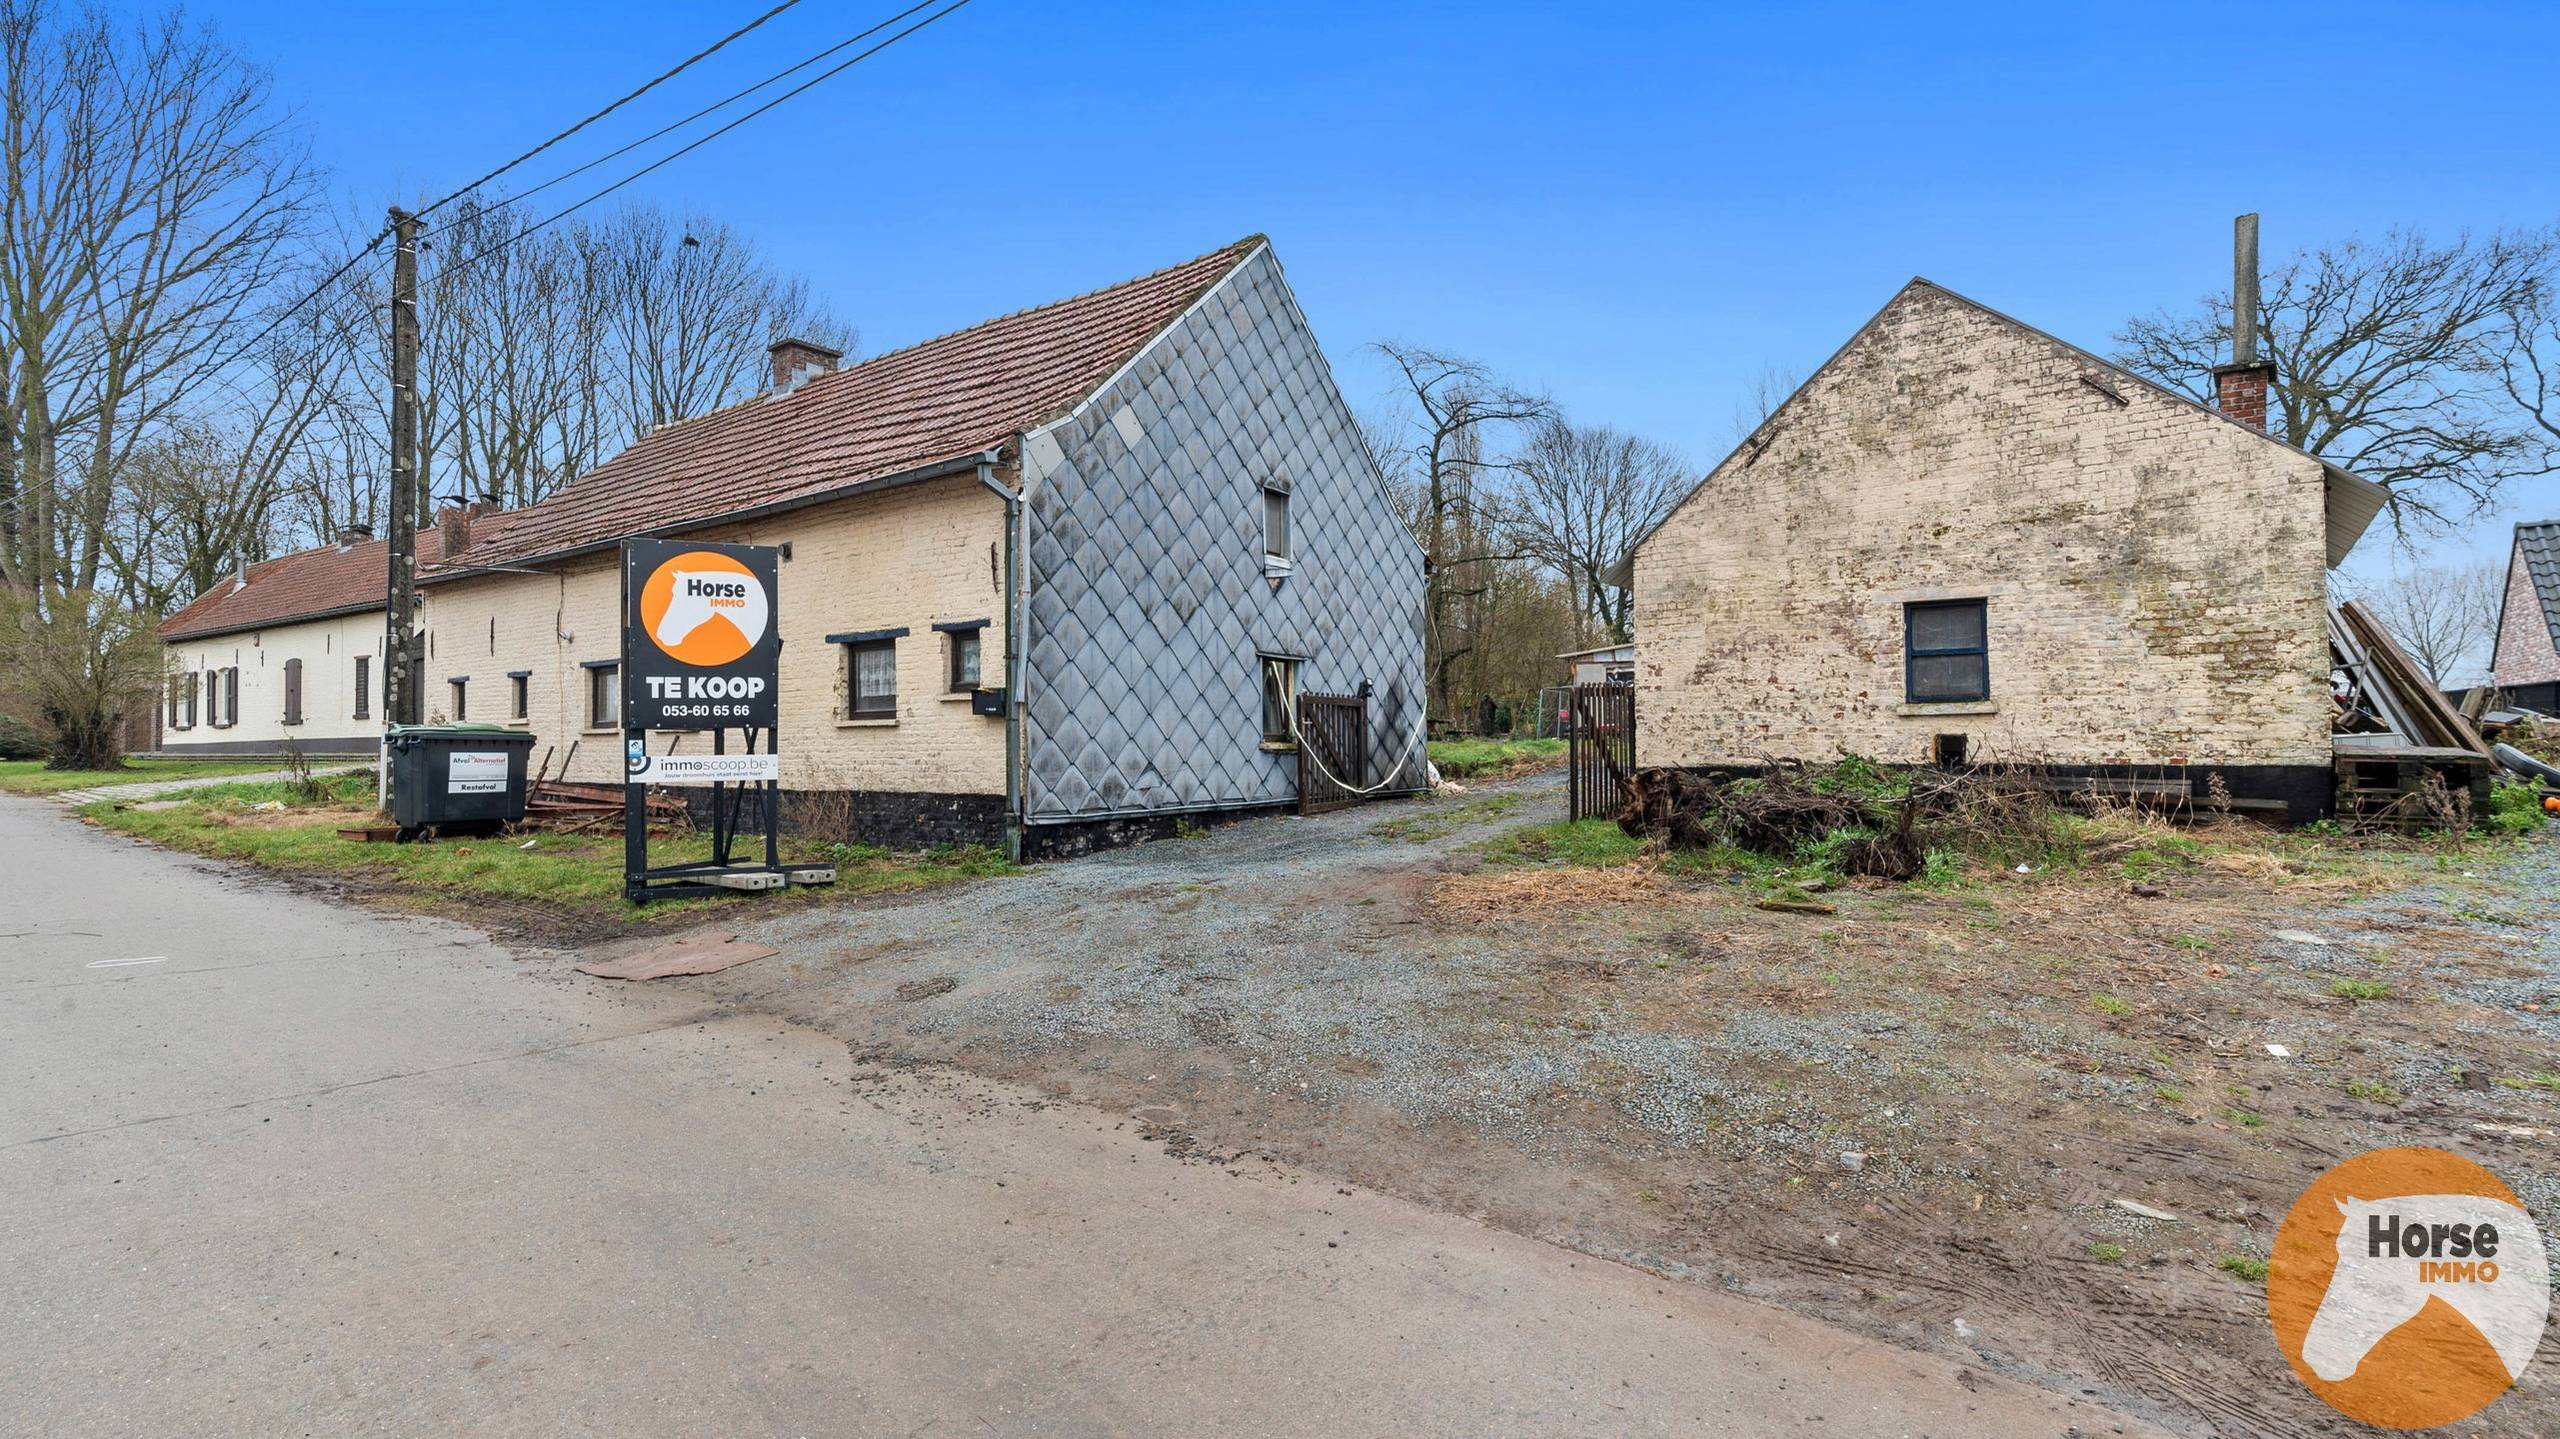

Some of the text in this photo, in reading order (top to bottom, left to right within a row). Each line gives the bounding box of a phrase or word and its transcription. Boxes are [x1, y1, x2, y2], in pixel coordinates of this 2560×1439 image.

[687, 579, 746, 598] Horse
[710, 599, 746, 608] IMMO
[645, 676, 765, 699] TE KOOP
[662, 705, 750, 717] 053-60 65 66
[660, 758, 769, 774] immoscoop.be
[461, 783, 497, 791] Restafval
